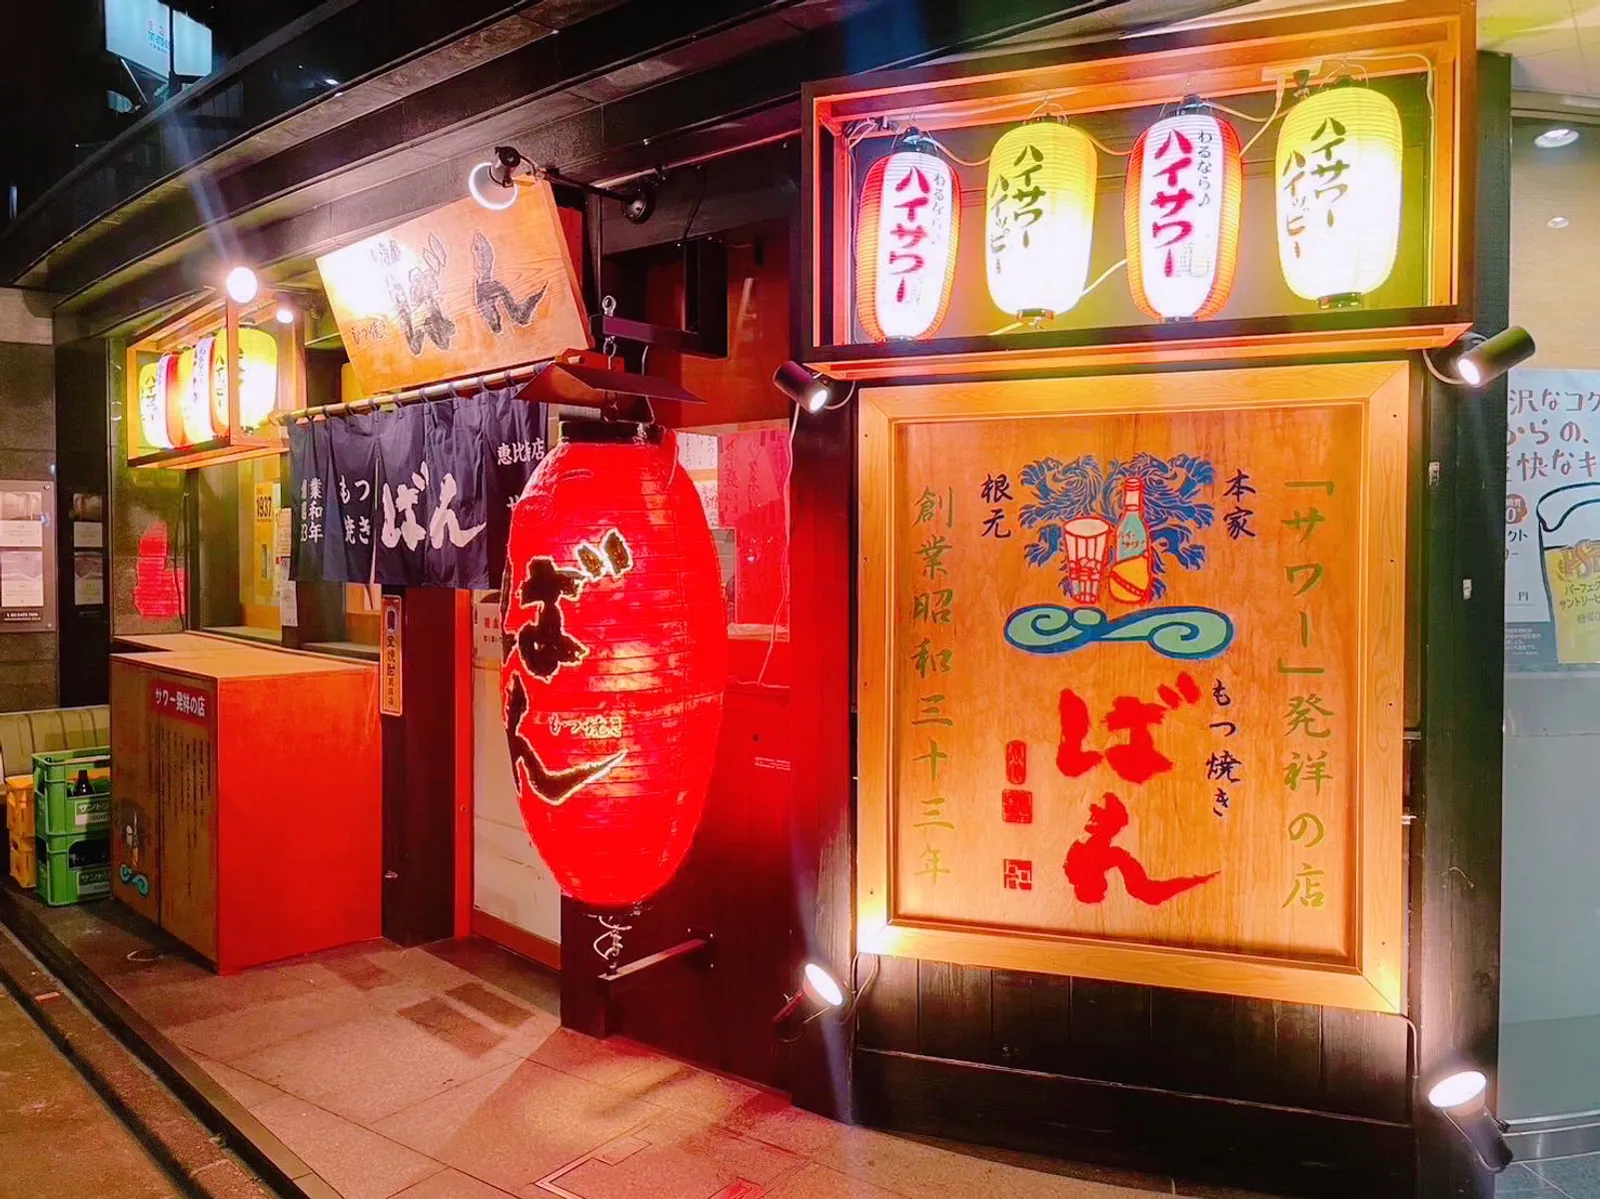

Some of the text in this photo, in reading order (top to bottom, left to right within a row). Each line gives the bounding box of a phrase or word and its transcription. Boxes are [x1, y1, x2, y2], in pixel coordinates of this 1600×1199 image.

[889, 165, 931, 303] ハイサワー
[1012, 144, 1046, 249] ハイサワー
[1150, 128, 1195, 278] ハイサワー
[1310, 116, 1351, 228] ハイサワー
[385, 231, 549, 357] ばん
[381, 460, 487, 552] ばん
[979, 473, 1014, 539] 根元
[1222, 468, 1257, 541] 本家
[1507, 449, 1597, 481] 快なキ
[155, 687, 206, 718] サワー発祥の店
[502, 530, 633, 806] ばん
[910, 484, 955, 887] 創業昭和三十三年
[1278, 480, 1335, 909] 「サワー」発祥の店
[1055, 670, 1222, 906] ばん
[1205, 678, 1242, 818] もつ焼き
